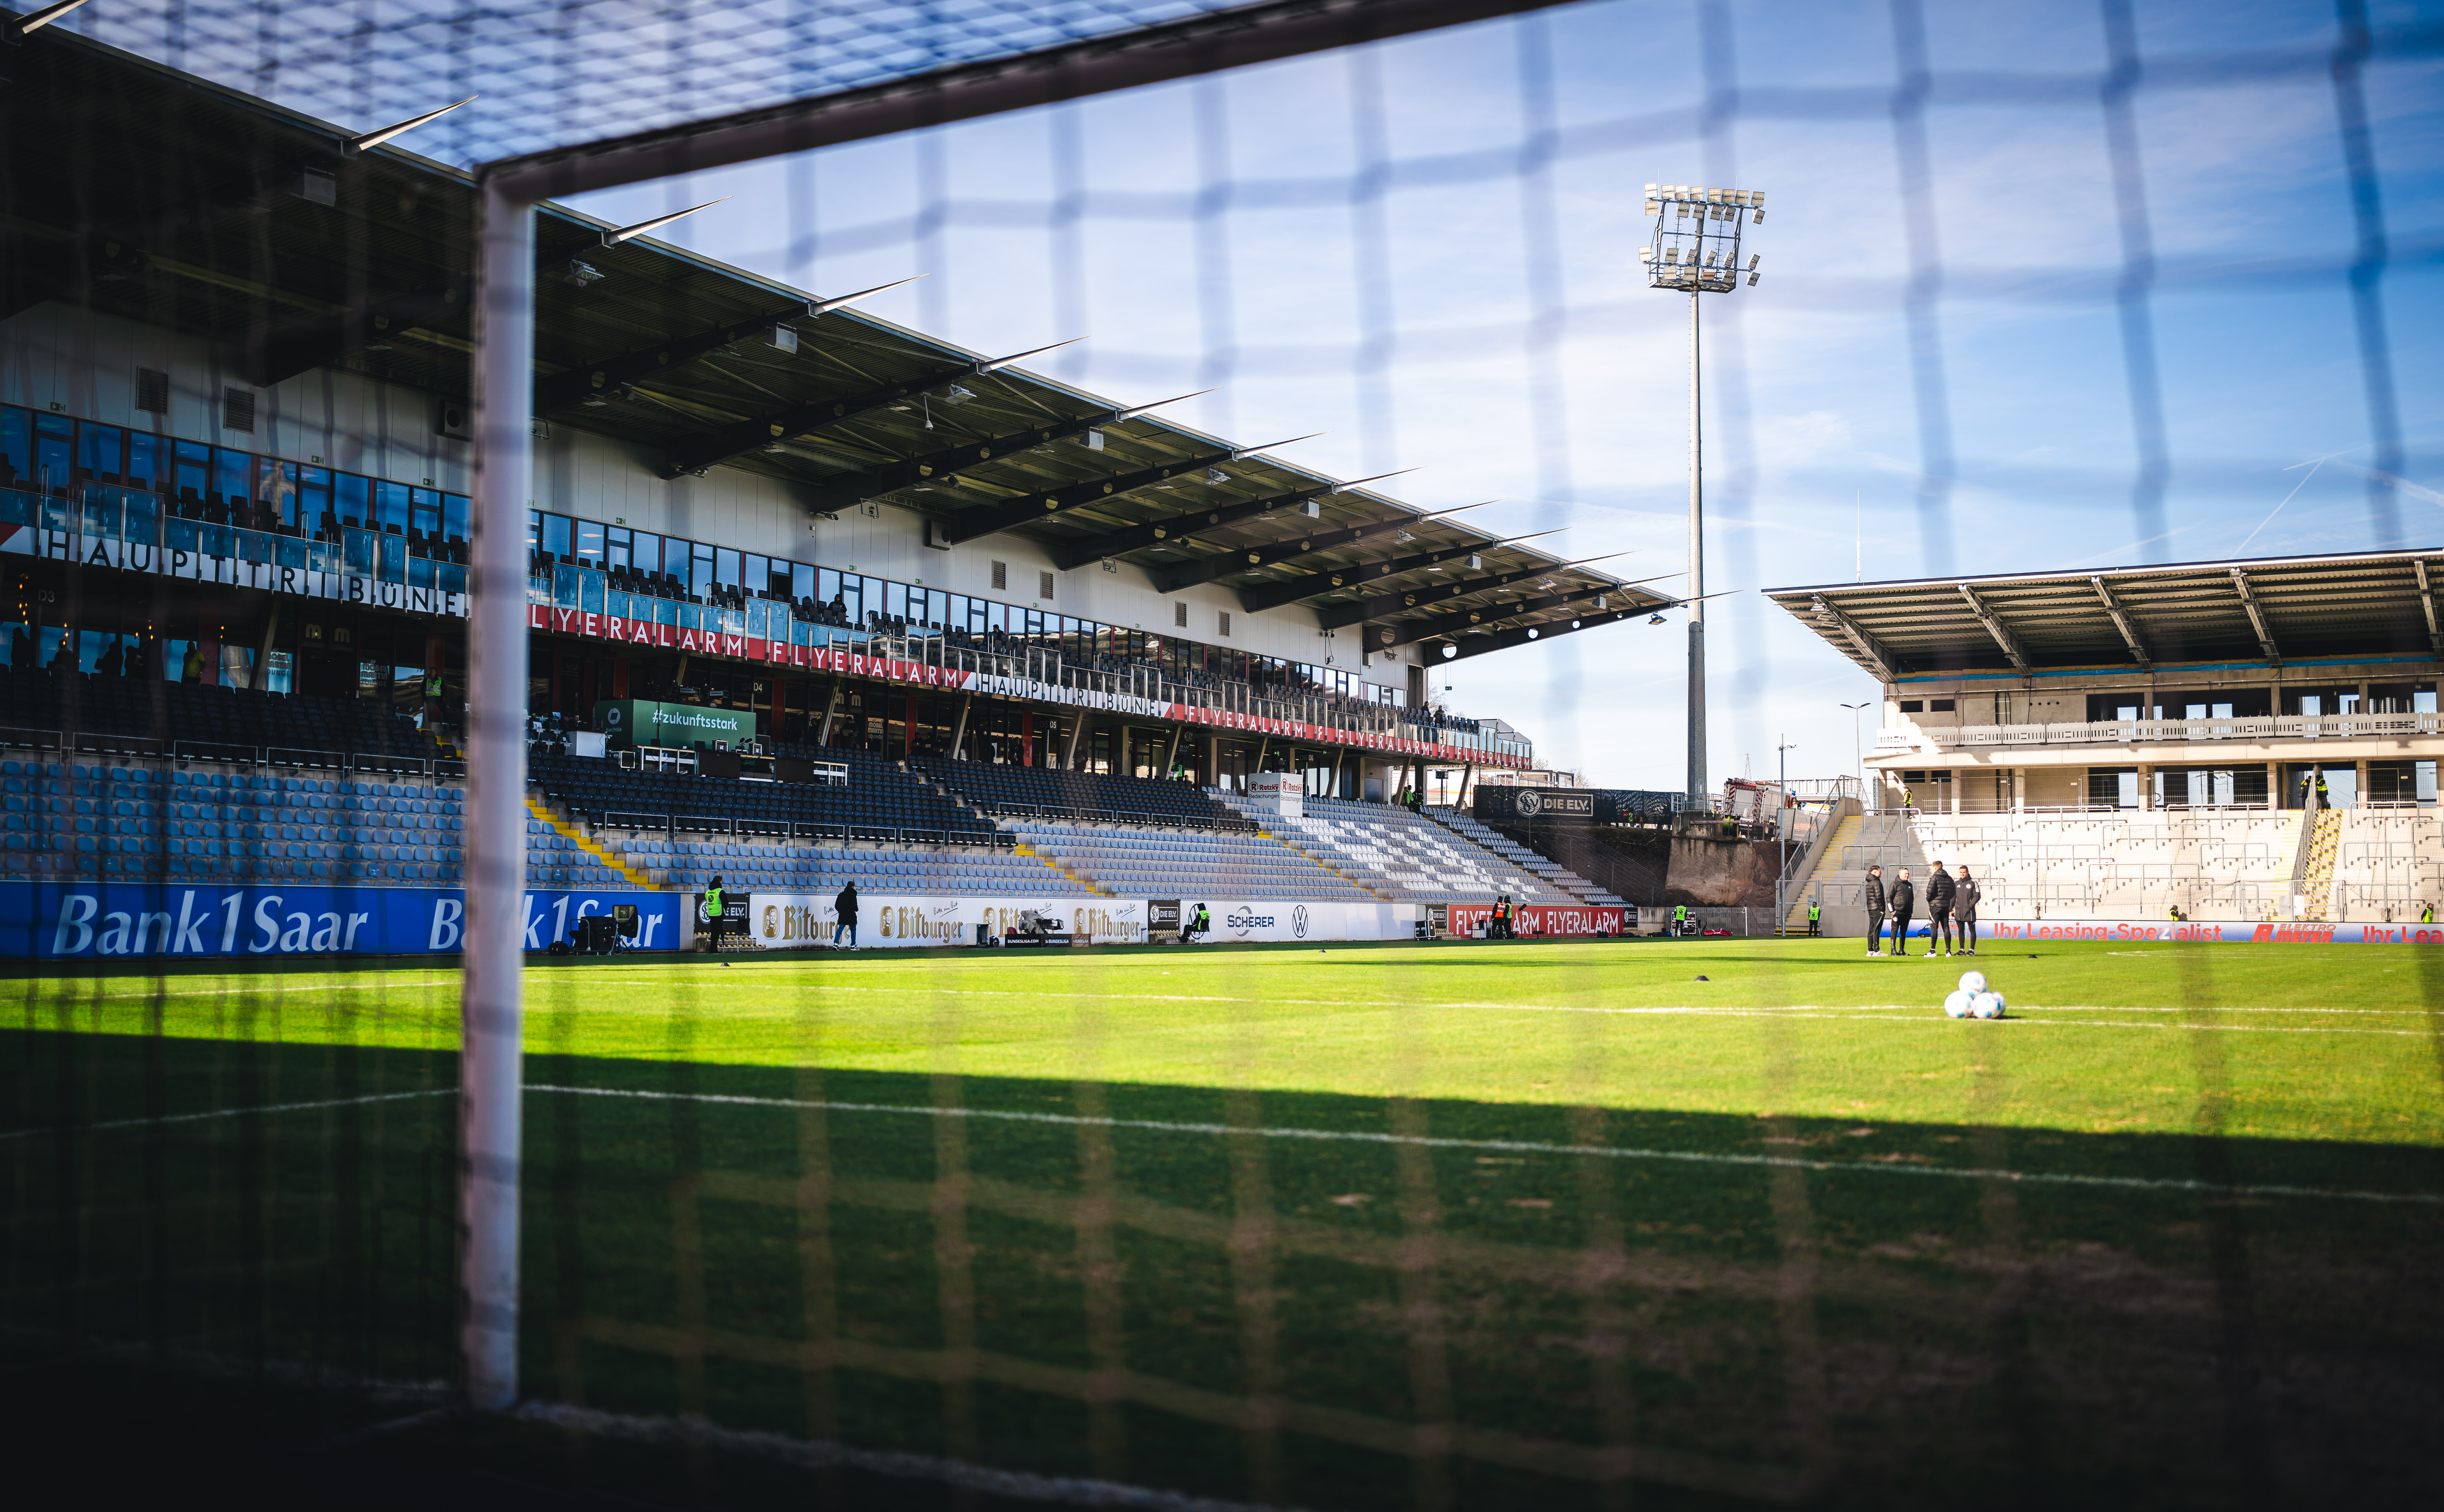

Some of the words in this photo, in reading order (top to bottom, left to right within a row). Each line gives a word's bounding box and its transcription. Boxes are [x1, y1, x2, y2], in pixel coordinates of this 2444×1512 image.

[47, 528, 458, 616] HAUPTTRIBÜNE
[531, 604, 742, 657] LYERALARM
[773, 642, 957, 688] FLYERALARM
[753, 682, 763, 692] D4
[981, 674, 1156, 715] HAUPTTRIBÜNE
[652, 709, 738, 731] #zukunftsstark
[1050, 720, 1057, 729] D5
[1188, 706, 1304, 738] FLYERALARM
[1338, 729, 1429, 756] FLYERALARM
[1457, 746, 1531, 770] FLYERALARM
[1544, 799, 1564, 810] DIE
[897, 905, 964, 944] Bitburger
[1088, 907, 1140, 942] Bitburger
[1160, 910, 1168, 918] DIE
[1228, 914, 1275, 928] SCHERER
[1547, 910, 1619, 935] FLYERALARM
[1994, 922, 2022, 938] Ihr
[2027, 921, 2223, 942] Leasing-Spezialist
[2363, 925, 2395, 943] Ihr
